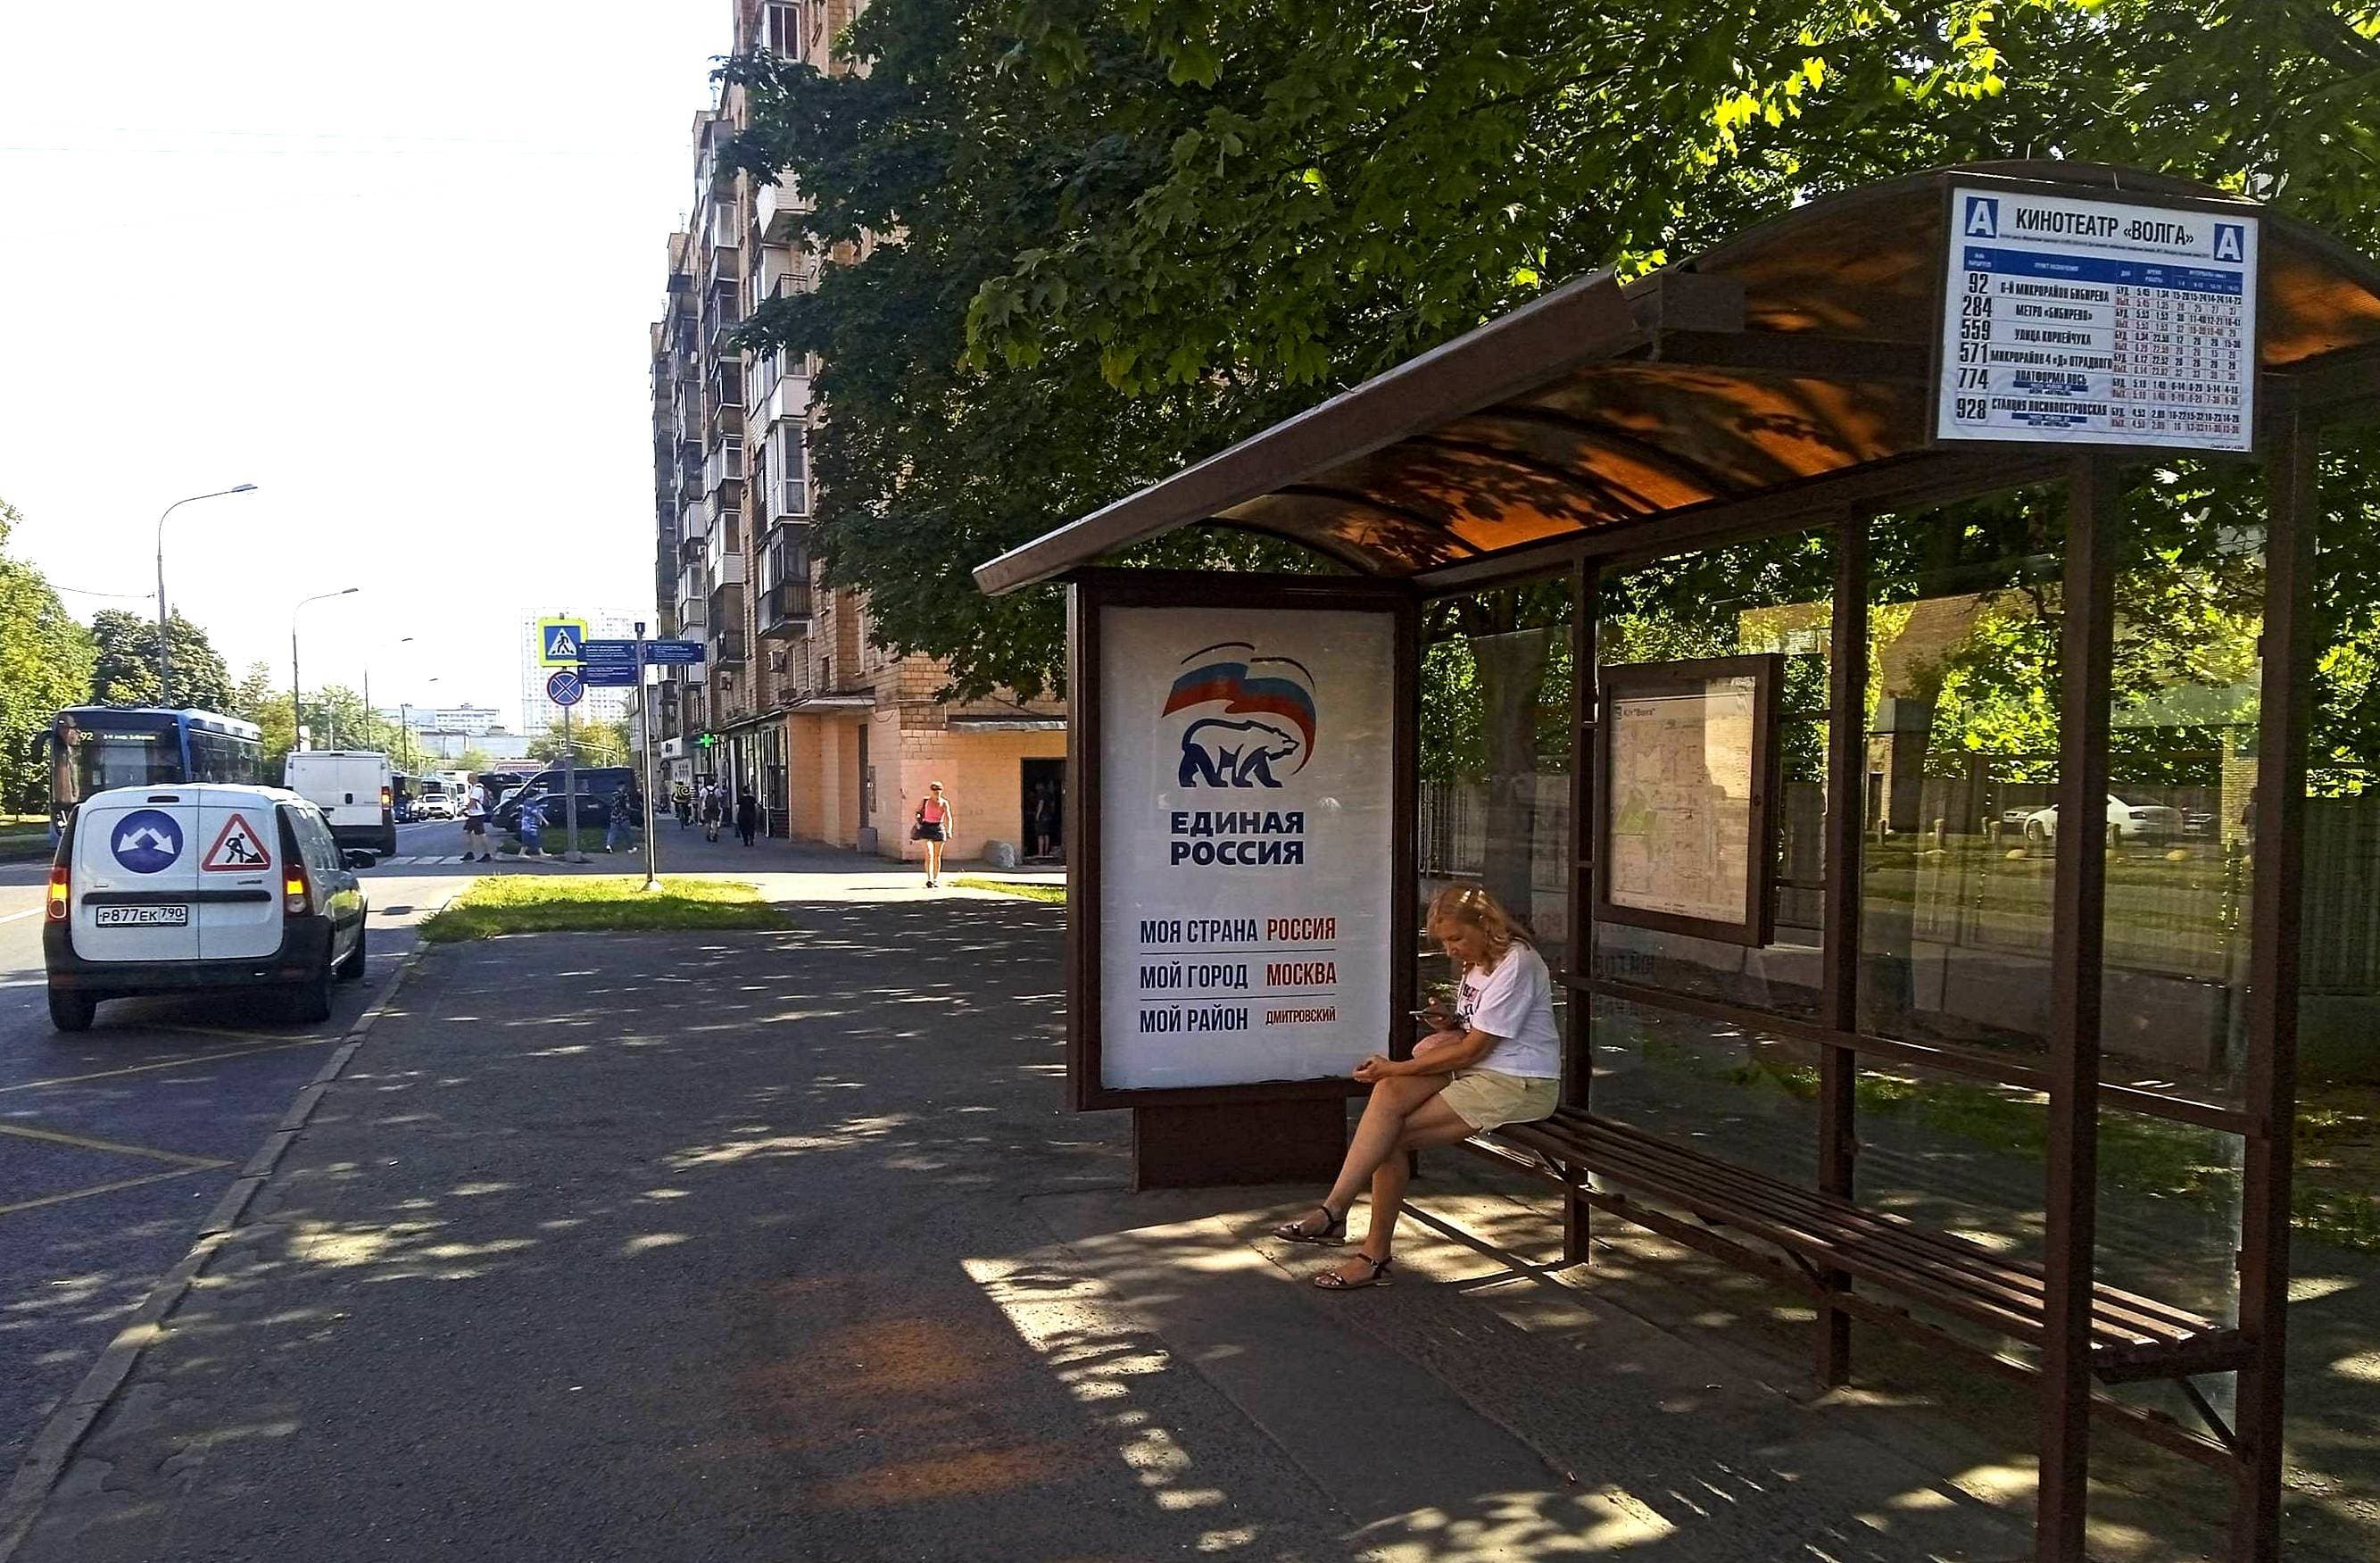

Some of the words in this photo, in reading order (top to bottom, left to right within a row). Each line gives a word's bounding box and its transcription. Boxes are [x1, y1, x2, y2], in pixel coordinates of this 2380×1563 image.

[2016, 208, 2119, 237] КИНОТЕАТР
[2123, 220, 2194, 245] «ВОЛГА»
[1969, 272, 1989, 294] 92
[1963, 295, 1992, 318] 284
[2016, 303, 2042, 317] МЕТРО
[1961, 319, 1991, 340] 559
[2014, 328, 2041, 343] УЛИЦА
[1960, 342, 1988, 364] 571
[2045, 353, 2051, 365] 4
[1958, 368, 1989, 390] 774
[2016, 370, 2065, 385] ПЛАТФОРМА
[1956, 398, 1986, 420] 928
[80, 732, 94, 741] 92
[1171, 811, 1305, 837] ЕДИНАЯ
[1170, 840, 1305, 866] РОССИЯ
[102, 909, 158, 922] Р877ЕК
[161, 908, 182, 919] 790
[1140, 919, 1181, 944] МОЯ
[1187, 919, 1258, 944] СТРАНА
[1266, 917, 1336, 942] РОССИЯ
[1140, 960, 1182, 990] МОЙ
[1187, 963, 1248, 990] ГОРОД
[1266, 961, 1337, 986] МОСКВА
[1140, 1003, 1182, 1034] МОЙ
[1187, 1003, 1248, 1033] РАЙОН
[1265, 1004, 1337, 1027] ДМИТРОВСКИЙ
